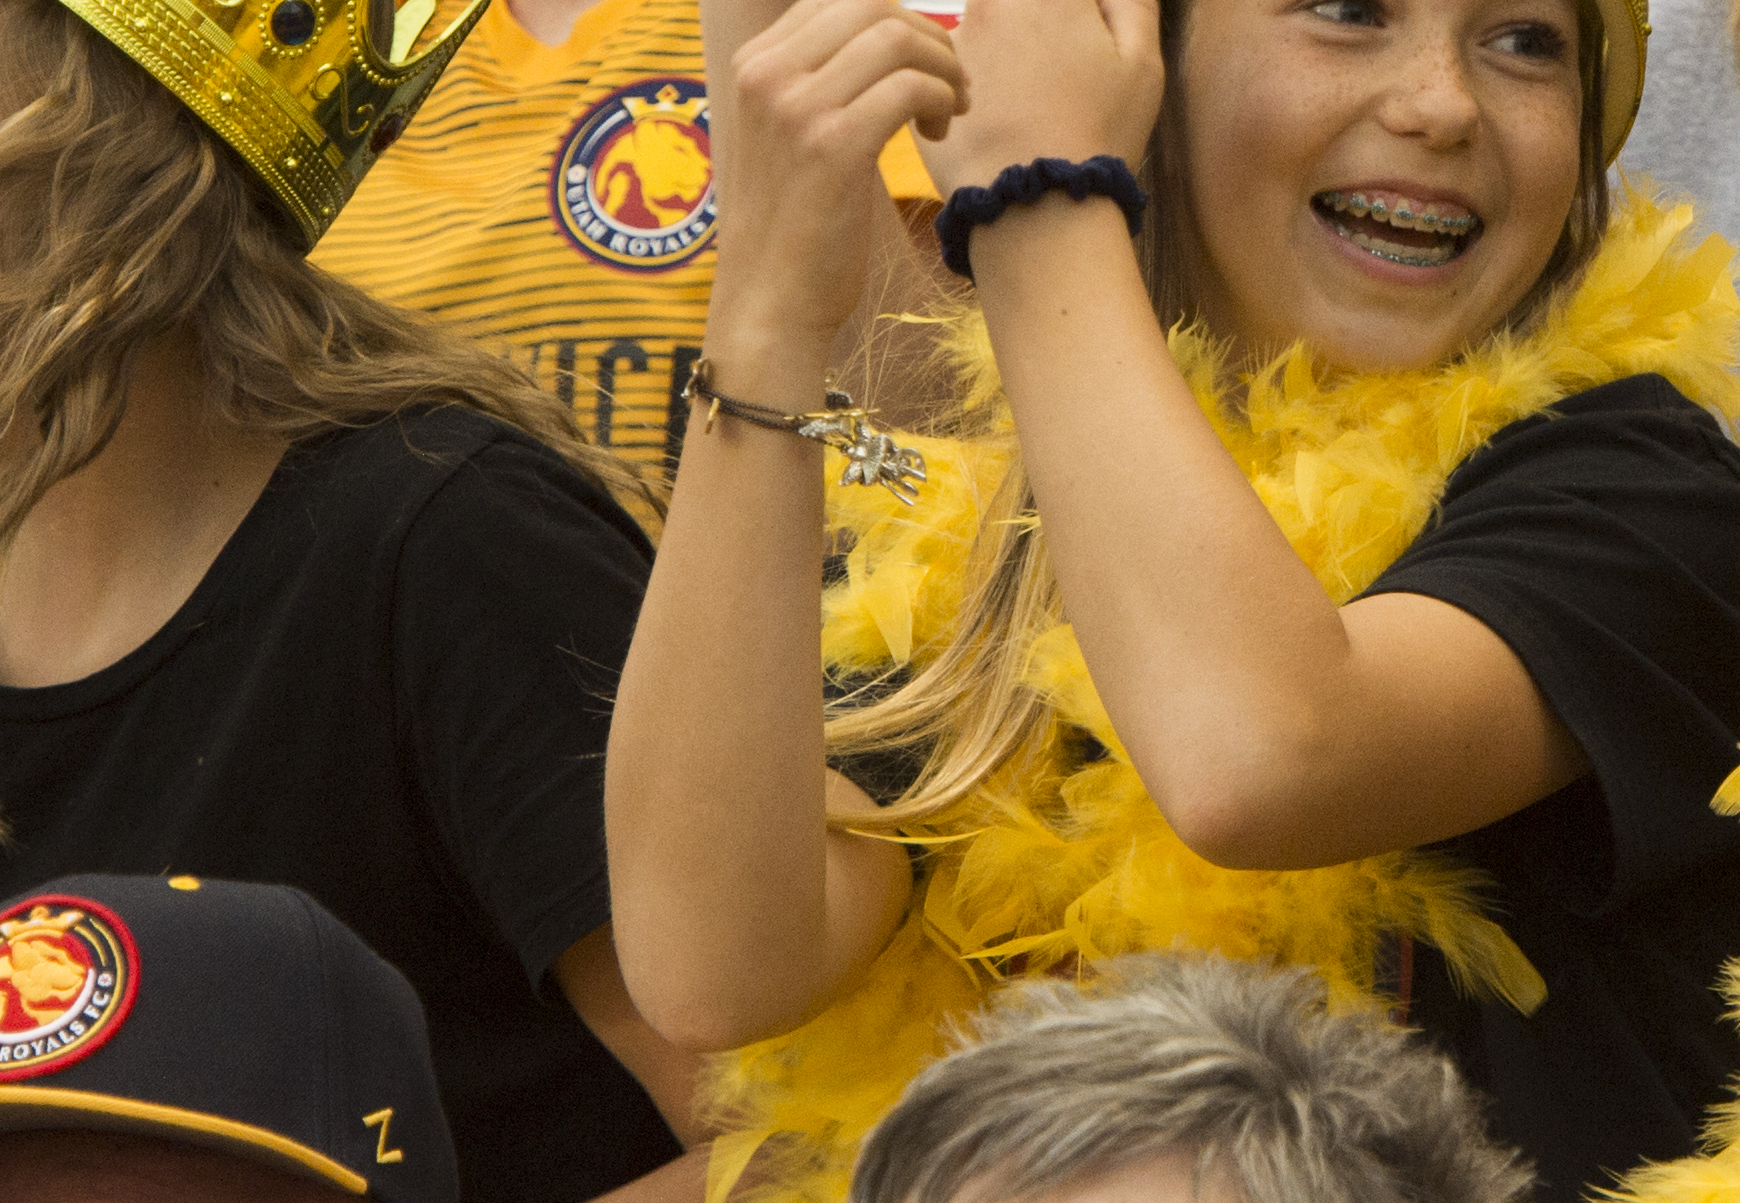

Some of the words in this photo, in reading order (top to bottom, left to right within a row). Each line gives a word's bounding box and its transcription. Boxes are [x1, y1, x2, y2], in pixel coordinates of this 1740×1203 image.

[565, 184, 608, 241] UTAH
[608, 221, 708, 258] ROYALS
[83, 990, 110, 1020] FC
[362, 1108, 404, 1164] Z
